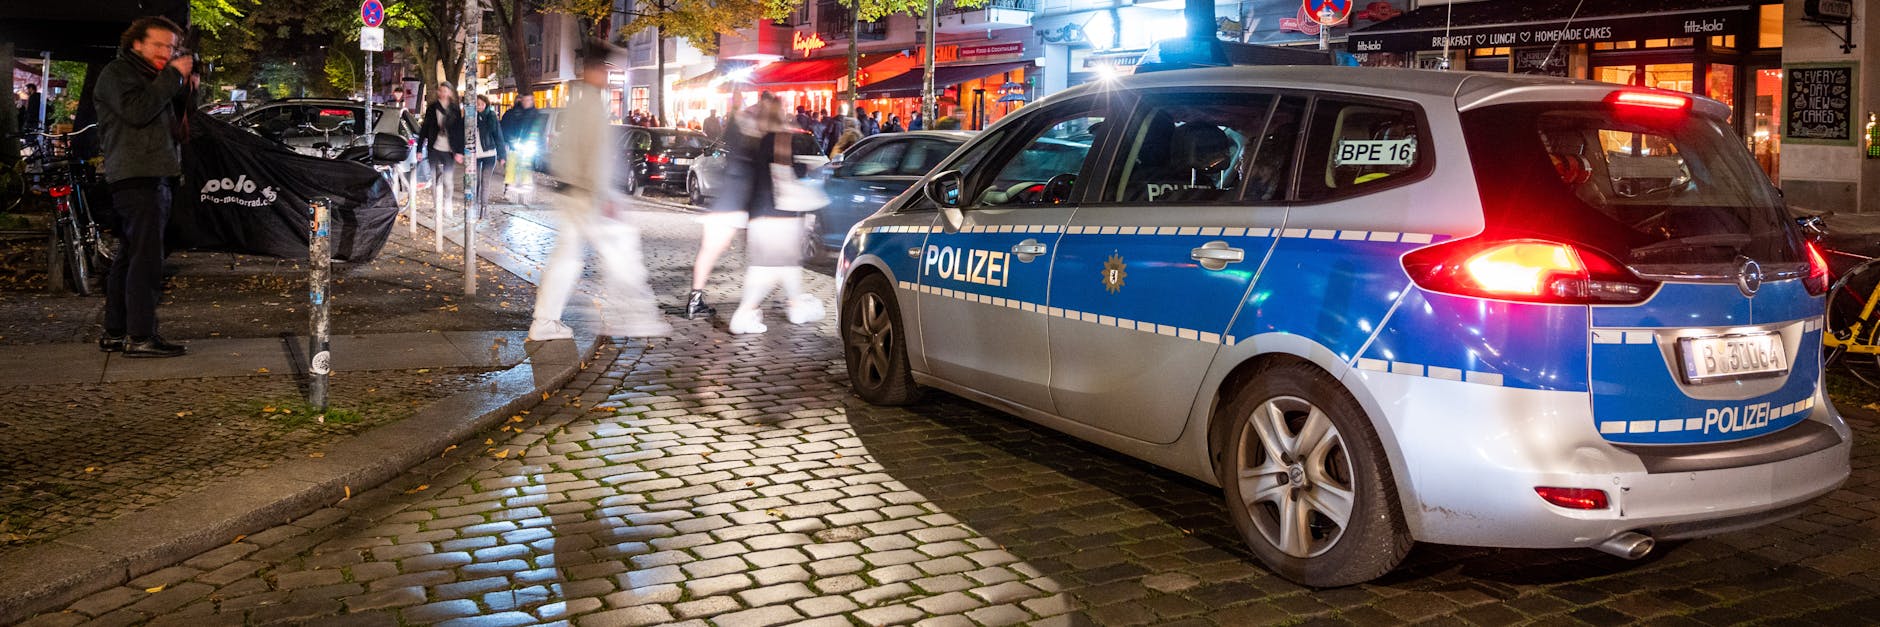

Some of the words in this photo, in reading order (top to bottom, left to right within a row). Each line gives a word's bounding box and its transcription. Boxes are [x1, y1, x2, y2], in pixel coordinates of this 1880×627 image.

[1490, 32, 1517, 45] LUNCH
[1534, 28, 1582, 42] HOMEMADE
[1584, 26, 1612, 40] CAKES
[1804, 70, 1838, 84] EVERY
[1809, 83, 1830, 97] DAY
[1808, 96, 1830, 110] NEW
[1802, 109, 1834, 124] CAKES
[1341, 143, 1383, 161] BPE
[1389, 143, 1412, 161] 16
[200, 174, 257, 194] polo
[924, 244, 1011, 288] POLIZEI
[1703, 344, 1717, 373] B
[1703, 401, 1771, 435] POLIZEI
